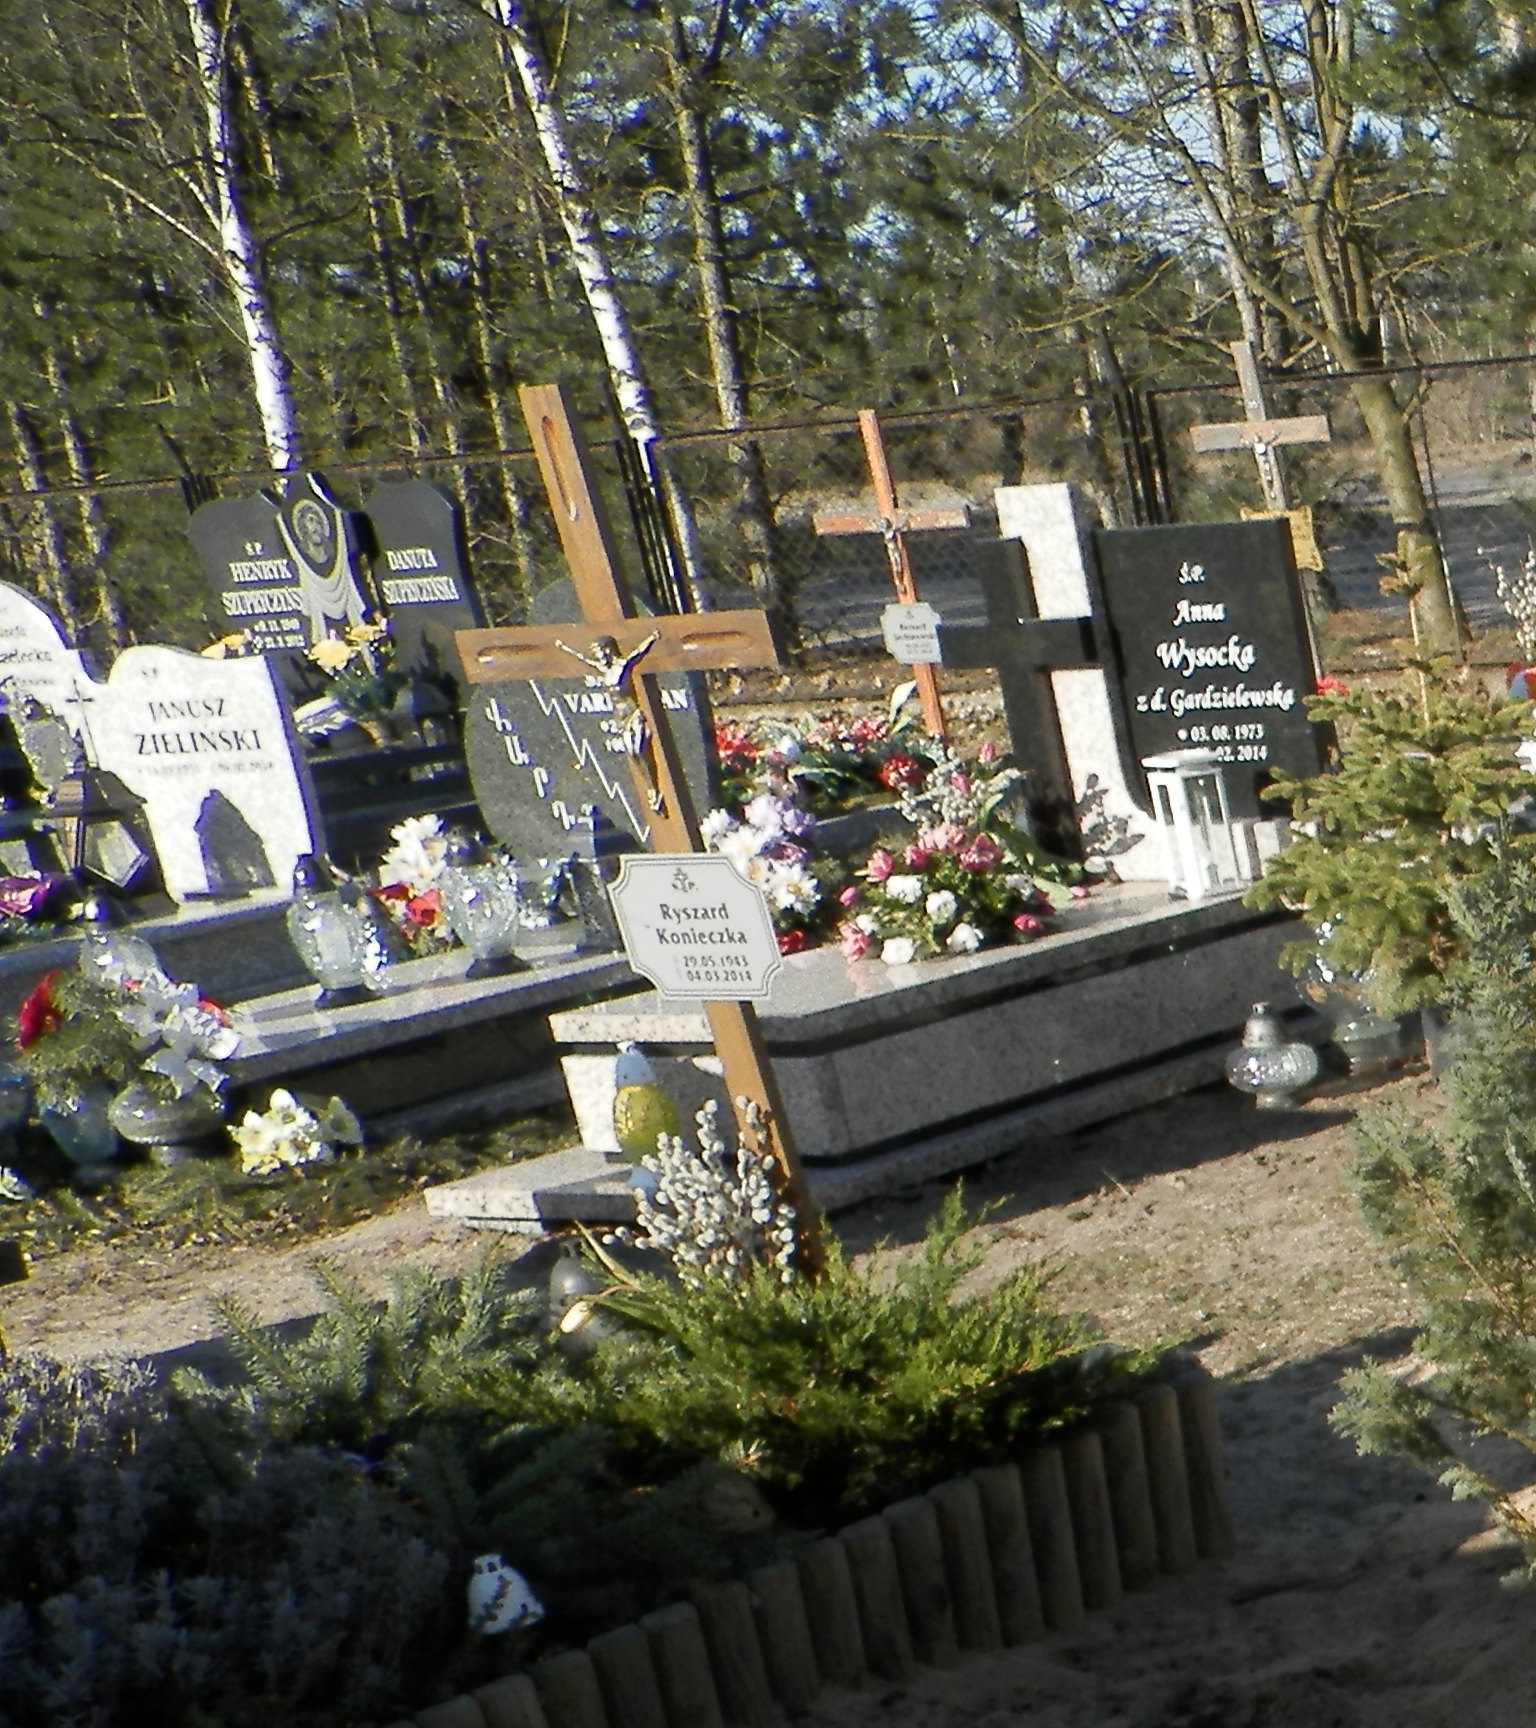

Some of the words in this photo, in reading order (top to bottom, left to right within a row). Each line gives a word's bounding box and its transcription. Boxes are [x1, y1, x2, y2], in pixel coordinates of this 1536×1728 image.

[229, 559, 292, 583] HENRYK
[386, 548, 438, 572] DANUTA
[1172, 599, 1225, 627] Anna
[1156, 634, 1256, 678] Wysocka
[149, 698, 225, 722] JANUSZ
[1169, 681, 1295, 718] Gardzielewska
[135, 725, 263, 755] ZIELIŃSKI
[660, 903, 729, 924] Ryszard
[656, 928, 748, 945] Konieczka
